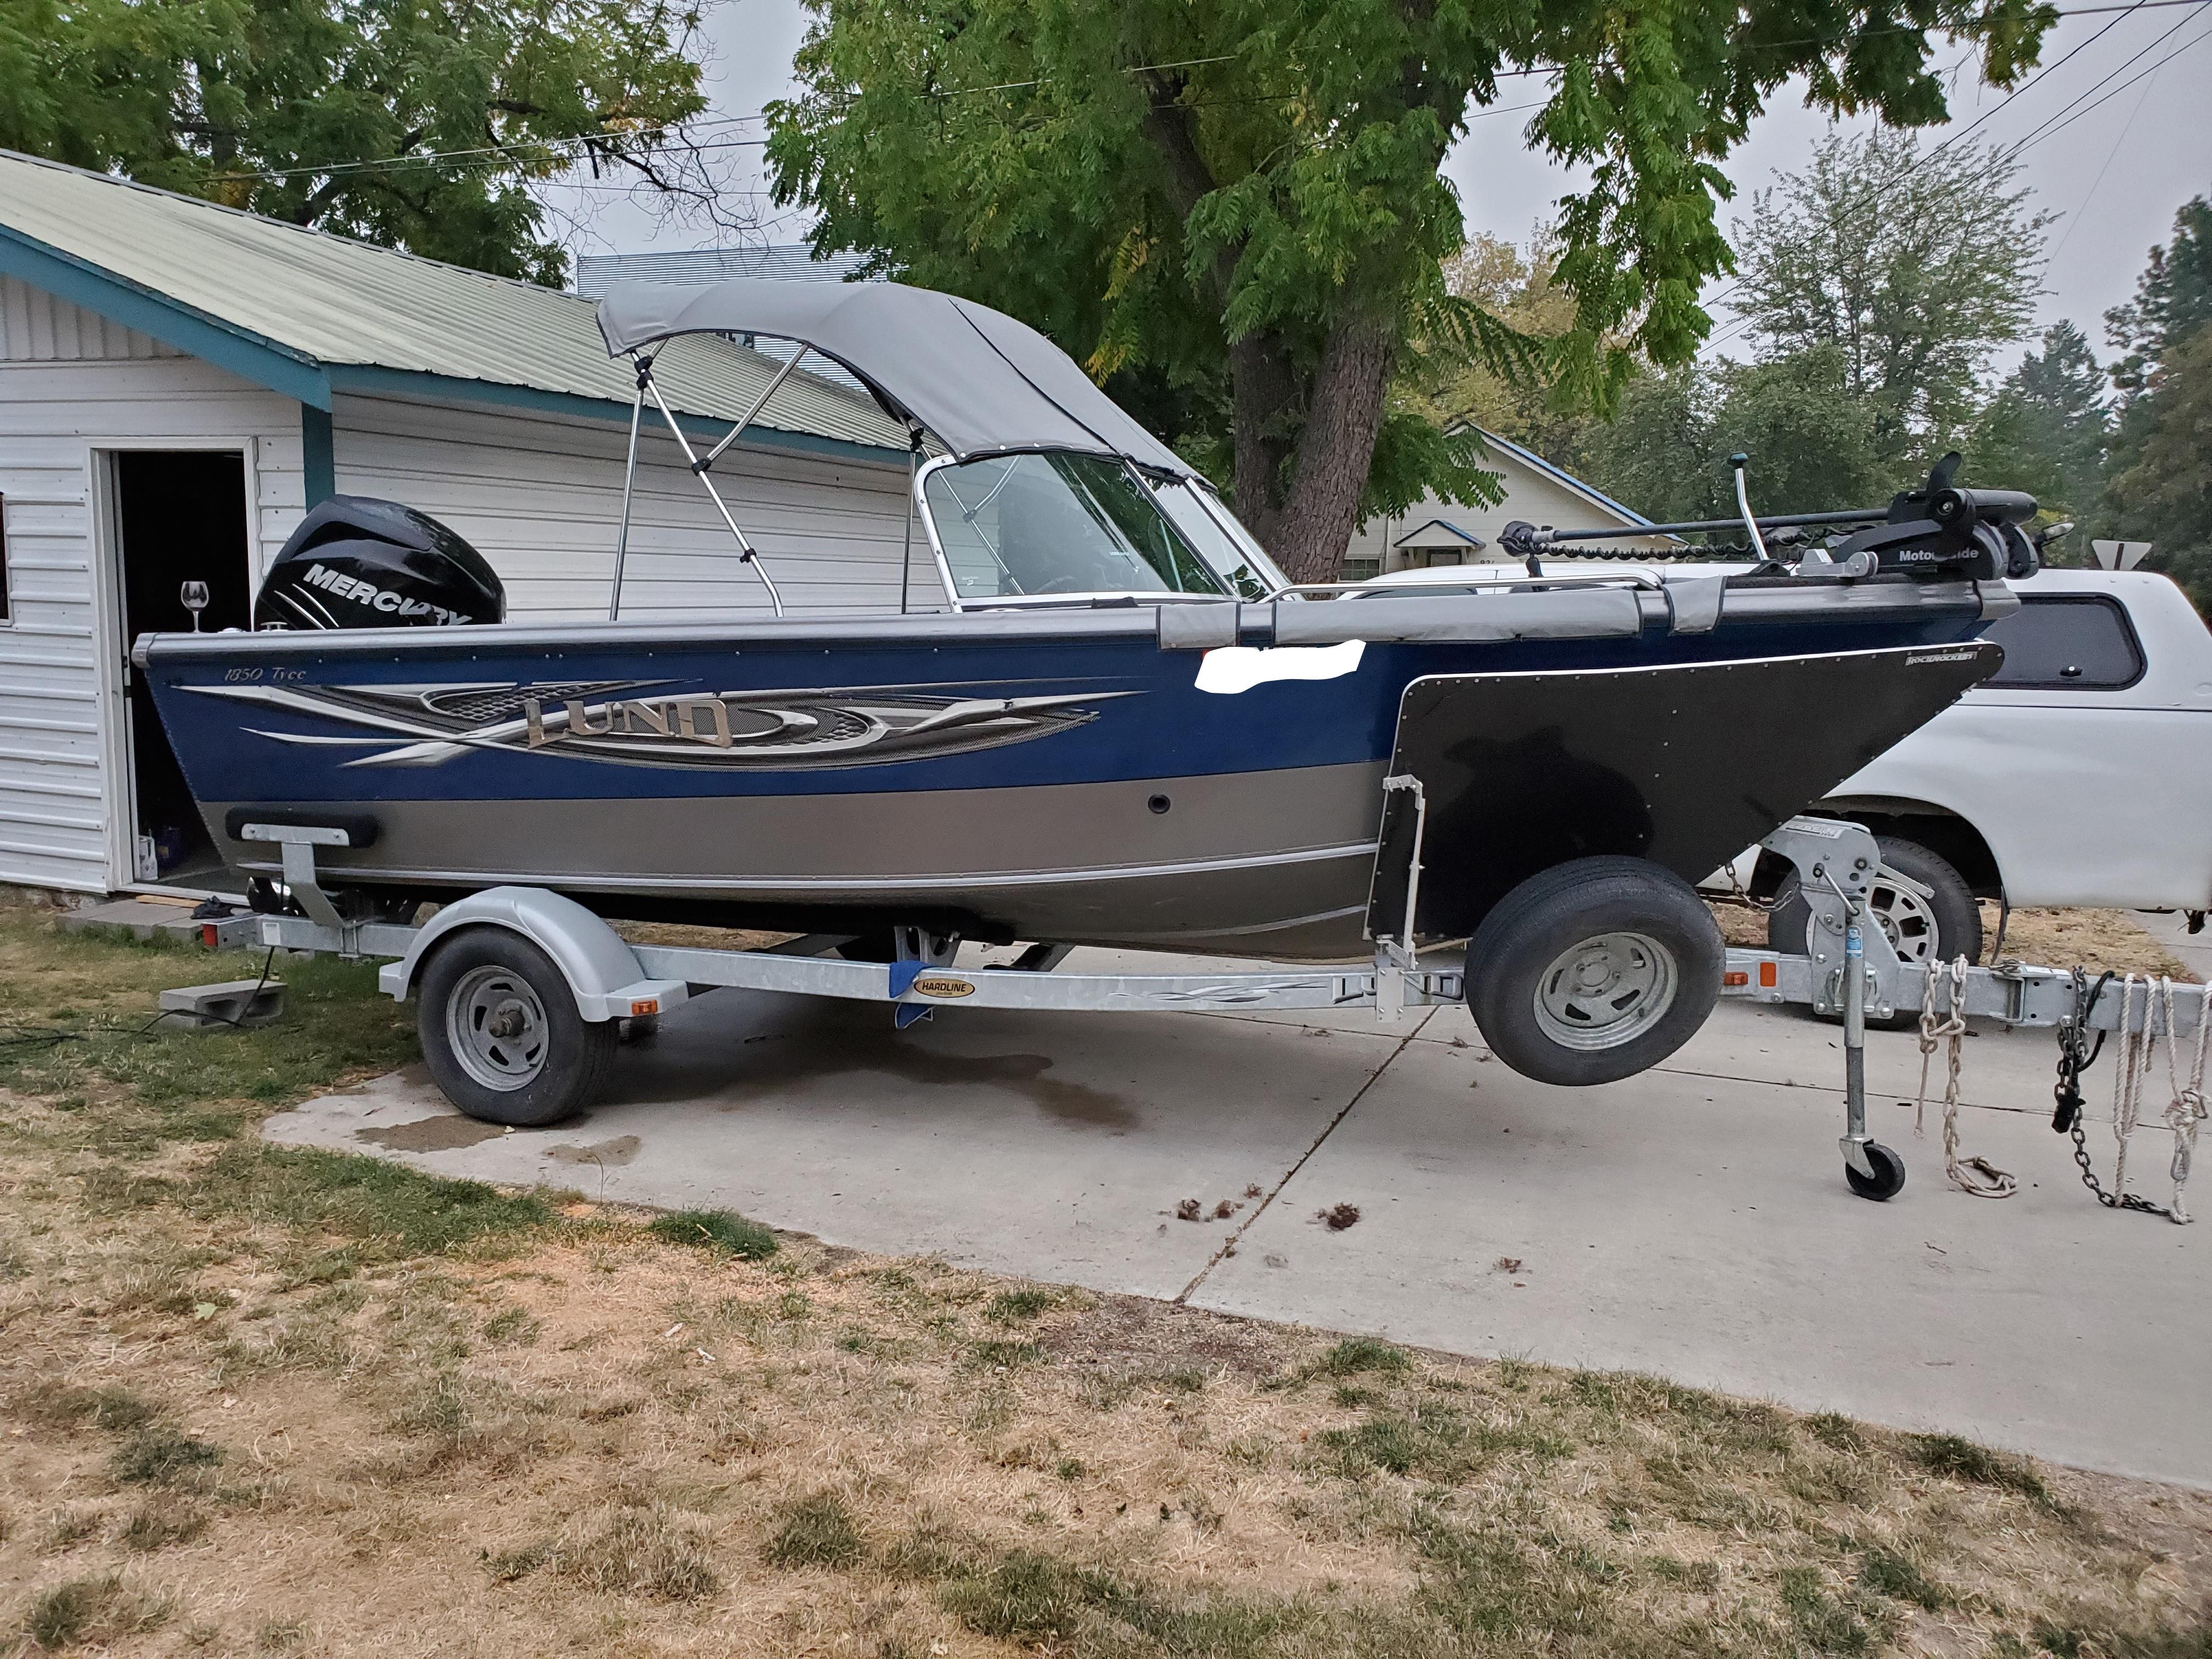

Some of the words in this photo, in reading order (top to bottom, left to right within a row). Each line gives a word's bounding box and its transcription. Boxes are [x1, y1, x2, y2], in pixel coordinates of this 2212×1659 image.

[224, 668, 263, 681] 1850
[516, 698, 733, 748] LUND
[922, 981, 967, 992] HARDLINE
